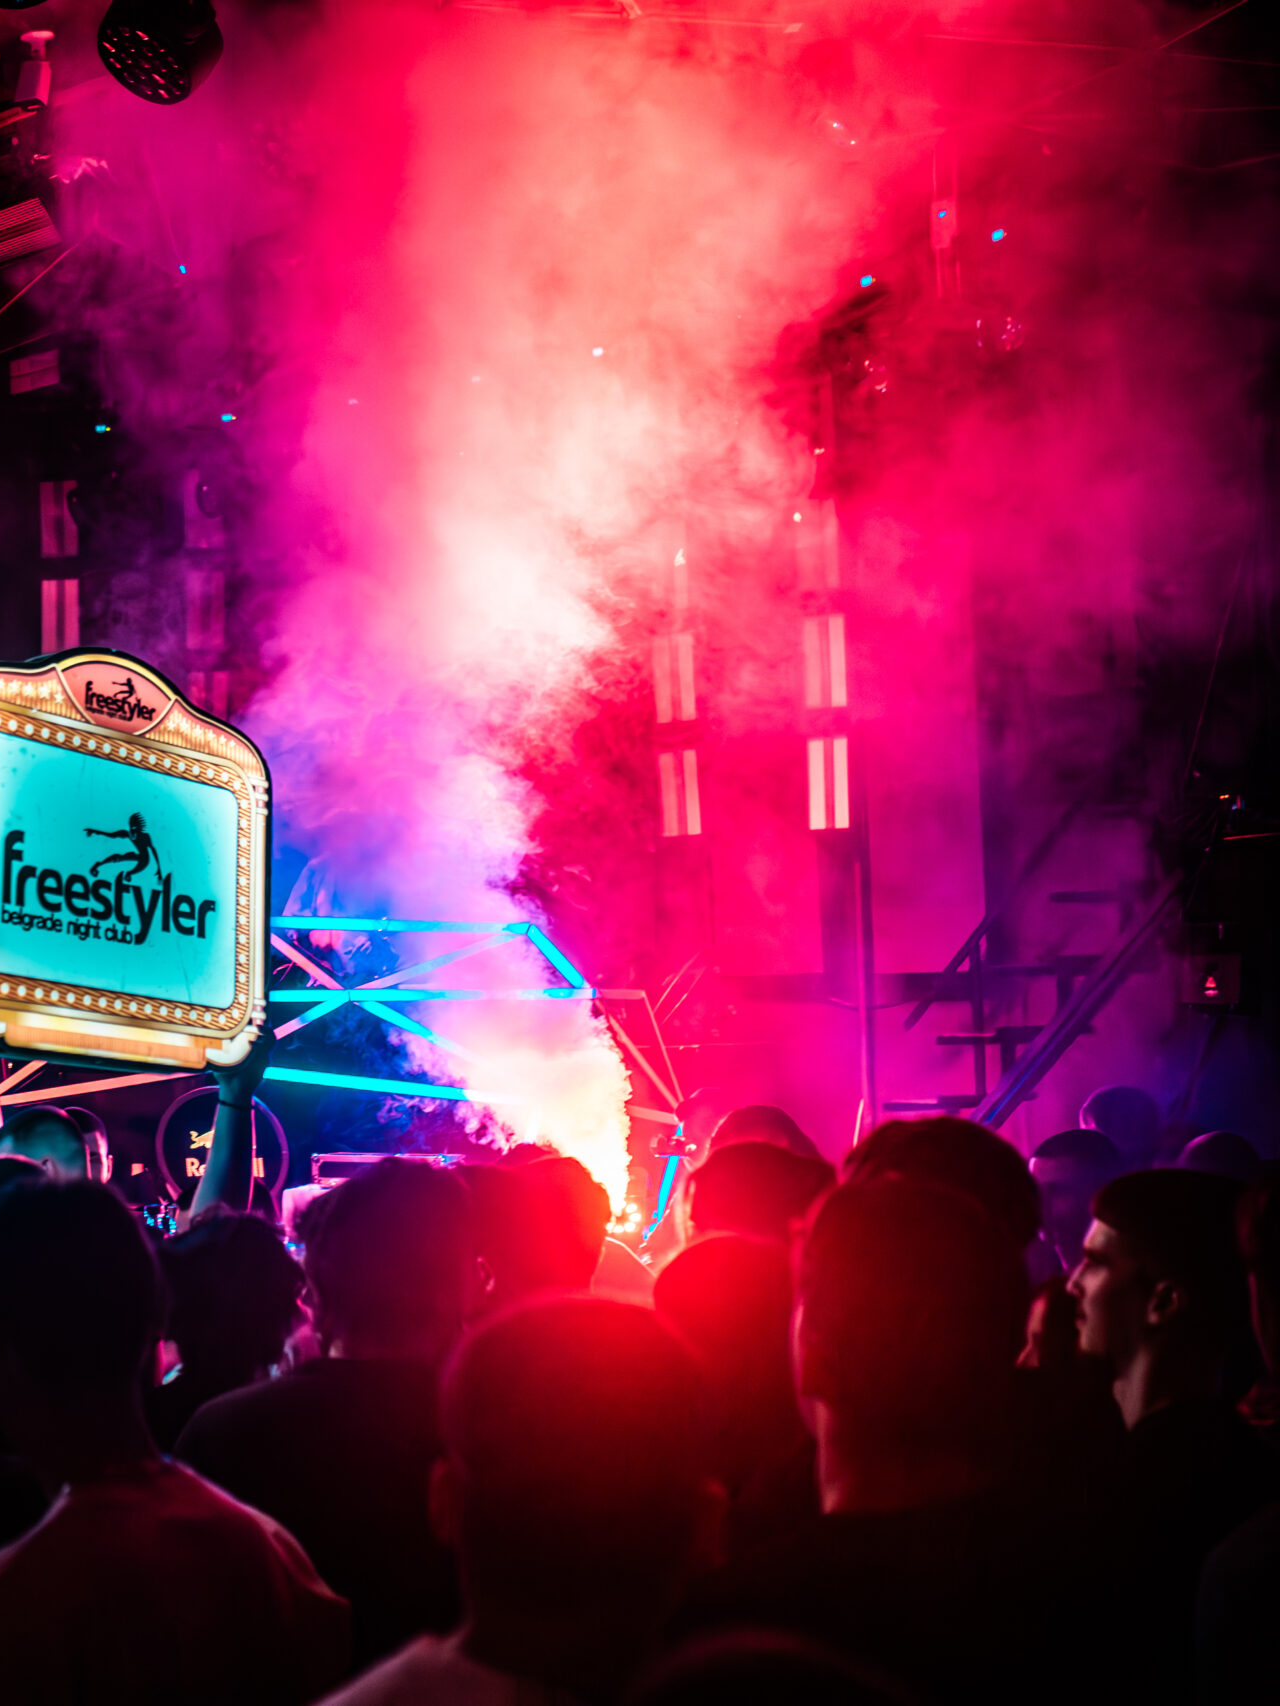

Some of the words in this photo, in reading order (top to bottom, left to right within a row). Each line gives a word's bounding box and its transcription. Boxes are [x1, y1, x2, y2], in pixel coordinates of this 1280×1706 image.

[85, 681, 156, 721] freestyler
[1, 829, 216, 945] freestyler
[1, 903, 63, 932] belgrade
[67, 918, 101, 941] night
[104, 923, 133, 945] club
